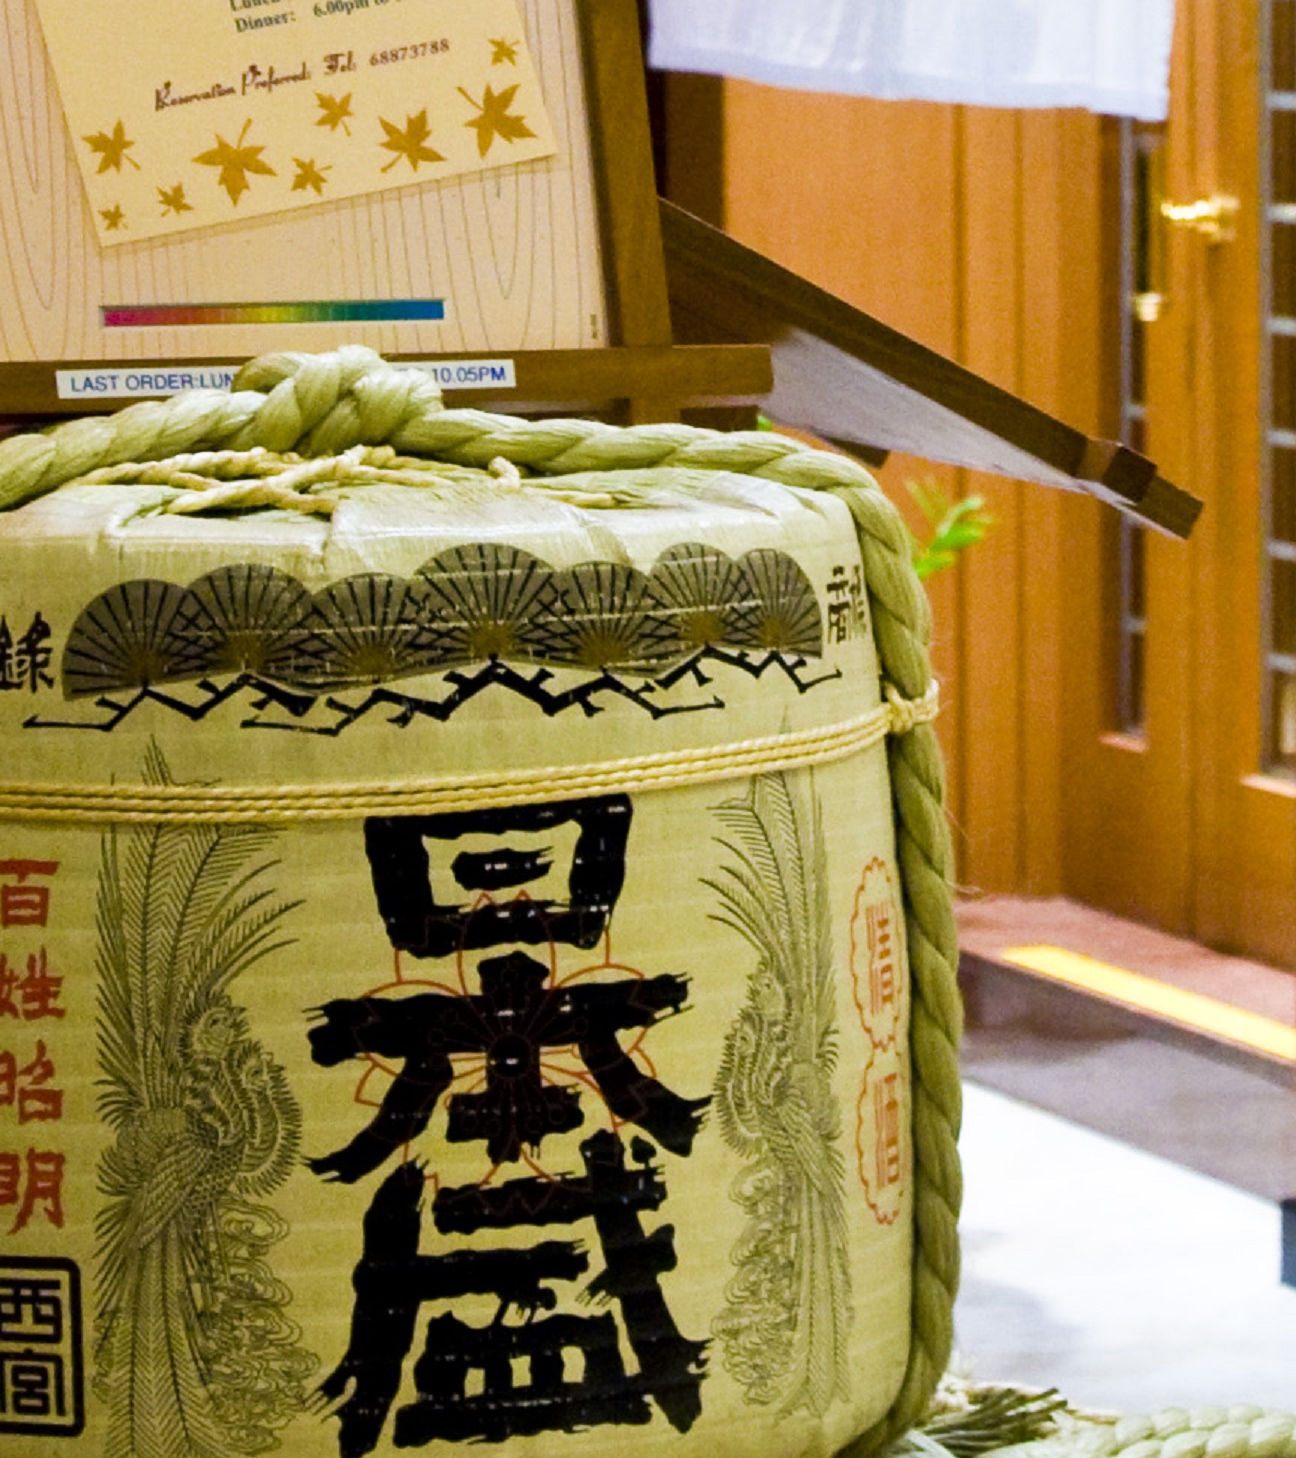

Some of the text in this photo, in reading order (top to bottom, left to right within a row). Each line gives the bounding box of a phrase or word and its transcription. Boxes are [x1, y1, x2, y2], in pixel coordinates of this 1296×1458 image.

[234, 10, 297, 33] Dinner:
[155, 80, 236, 112] Reservation
[369, 38, 450, 67] 68873788
[70, 374, 119, 393] LAST
